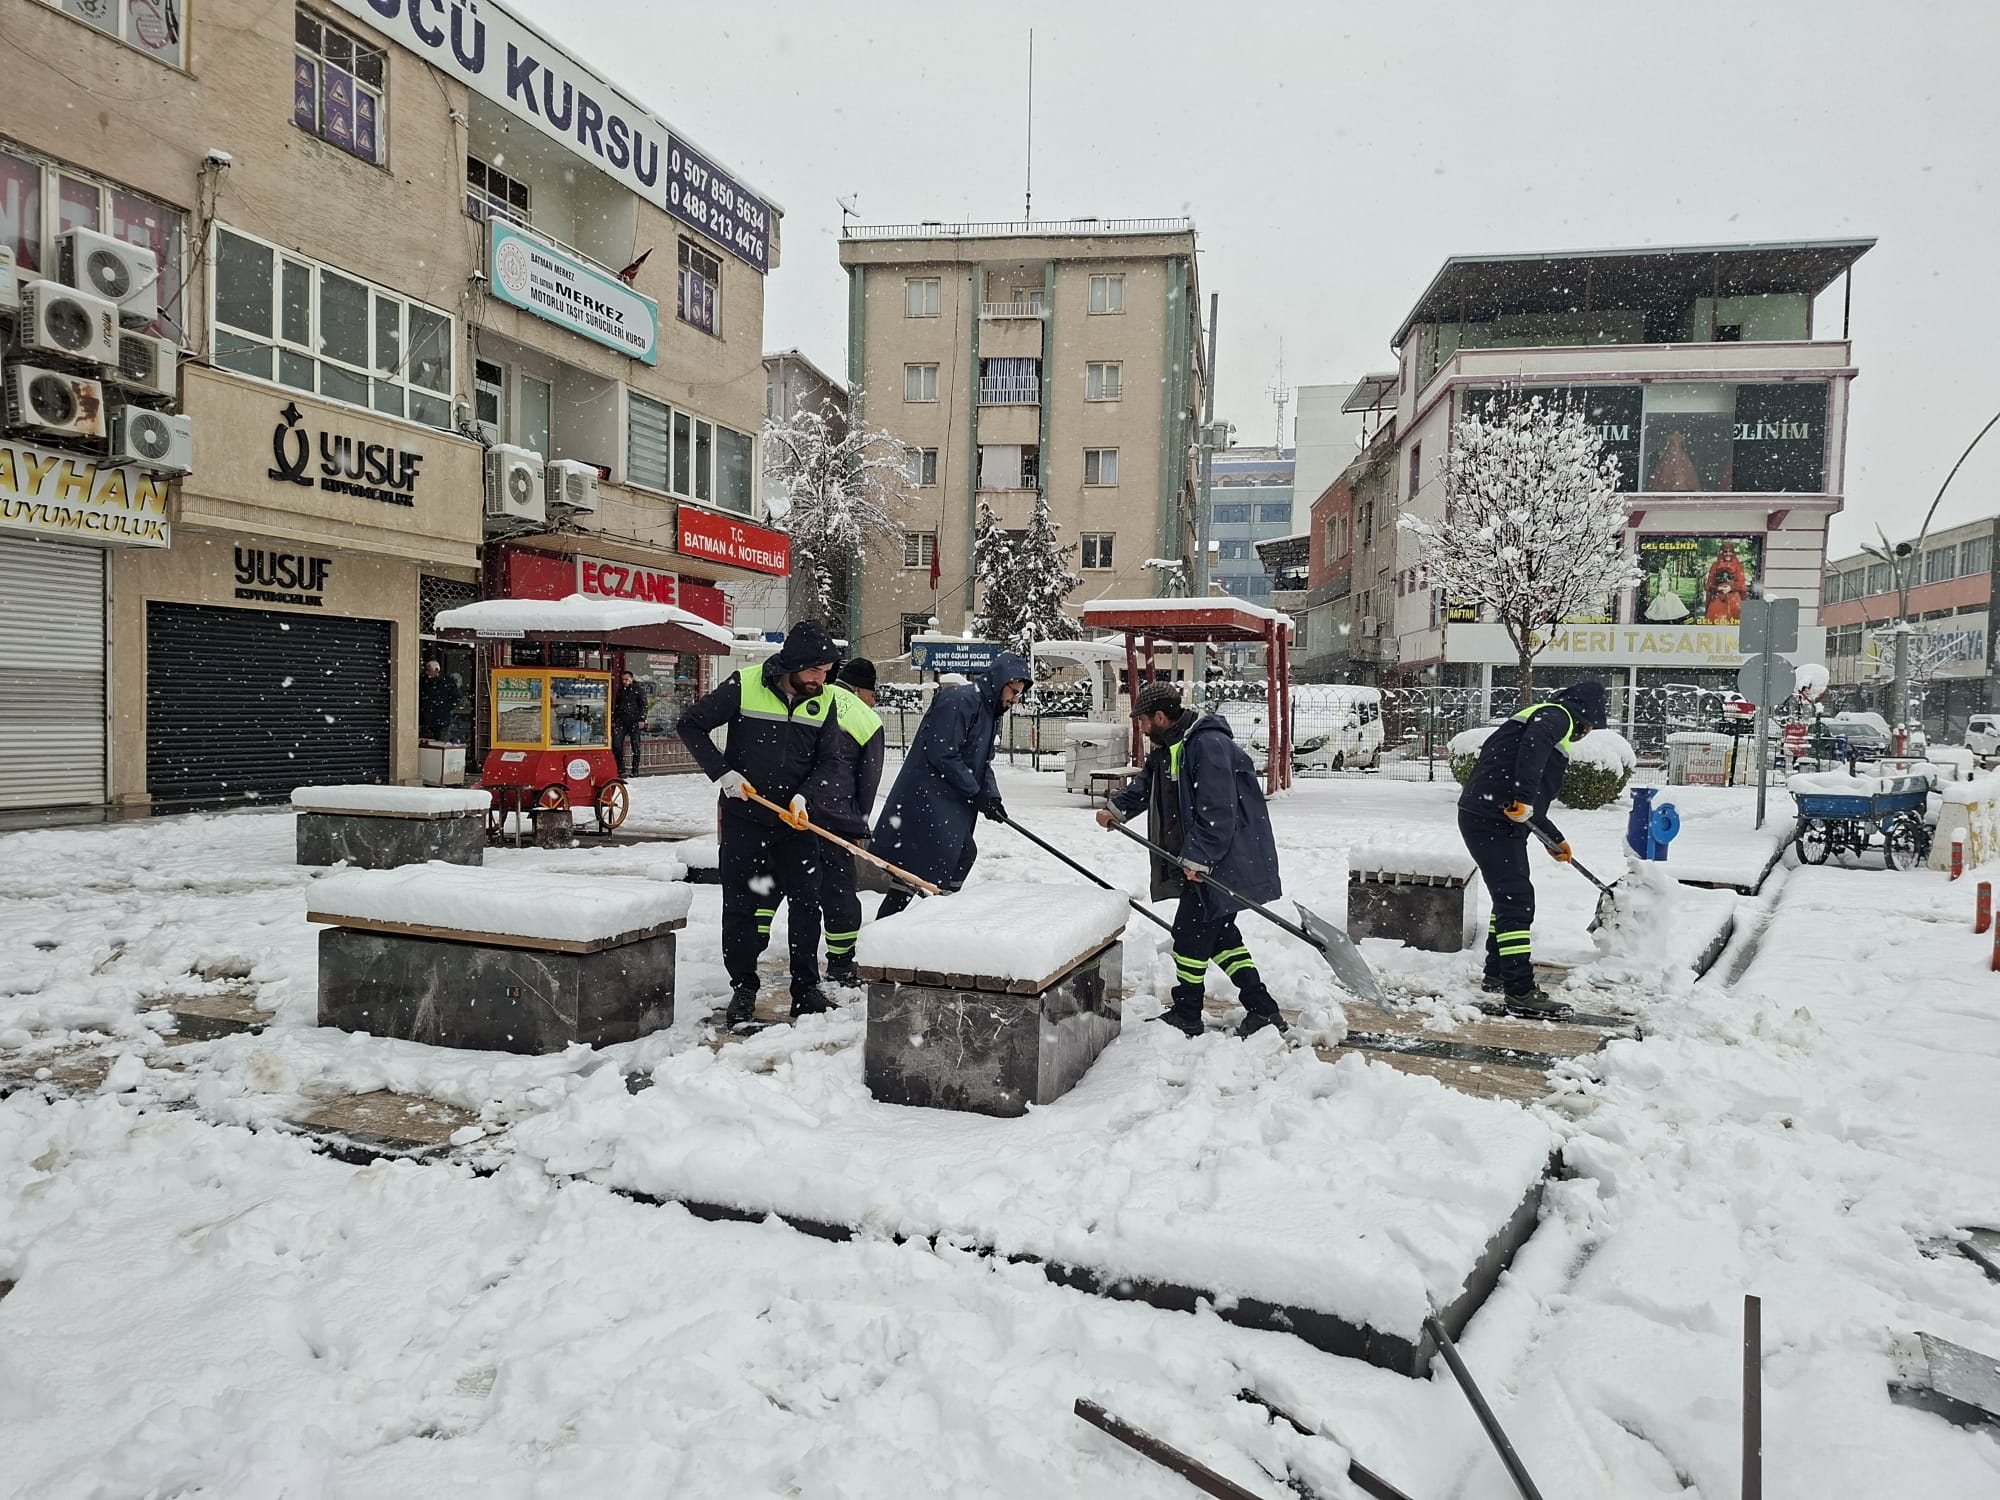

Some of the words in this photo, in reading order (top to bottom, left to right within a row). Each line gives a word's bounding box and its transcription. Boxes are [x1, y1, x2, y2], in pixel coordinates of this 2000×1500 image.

[366, 0, 485, 74] CÜ
[507, 42, 658, 187] KURSU
[671, 149, 680, 174] 0
[683, 158, 708, 192] 507
[711, 178, 734, 211] 850
[736, 197, 764, 233] 5634
[670, 181, 679, 205] 0
[682, 190, 707, 223] 488
[710, 208, 733, 240] 213
[735, 227, 763, 261] 4476
[530, 252, 553, 271] BATMAN
[554, 263, 575, 282] MERKEZ
[530, 287, 564, 312] MOTORLU
[566, 303, 584, 322] TAŞIT
[585, 311, 624, 340] SÜRÜCÜLERİ
[625, 330, 646, 349] KURSU
[539, 277, 554, 291] BATMAN
[555, 281, 625, 324] MERKEZ
[0, 448, 169, 514] AYHAN
[320, 431, 424, 492] YUSUF
[0, 497, 168, 541] UYUMCULUK
[730, 526, 745, 543] T.C.
[684, 531, 726, 555] BATMAN
[728, 543, 736, 558] 4.
[738, 545, 785, 569] NOTERLİĞİ
[1659, 542, 1697, 550] GELİNİM
[235, 547, 332, 591] YUSUF
[583, 560, 676, 605] ECZANE
[1623, 631, 1740, 654] TASARIM
